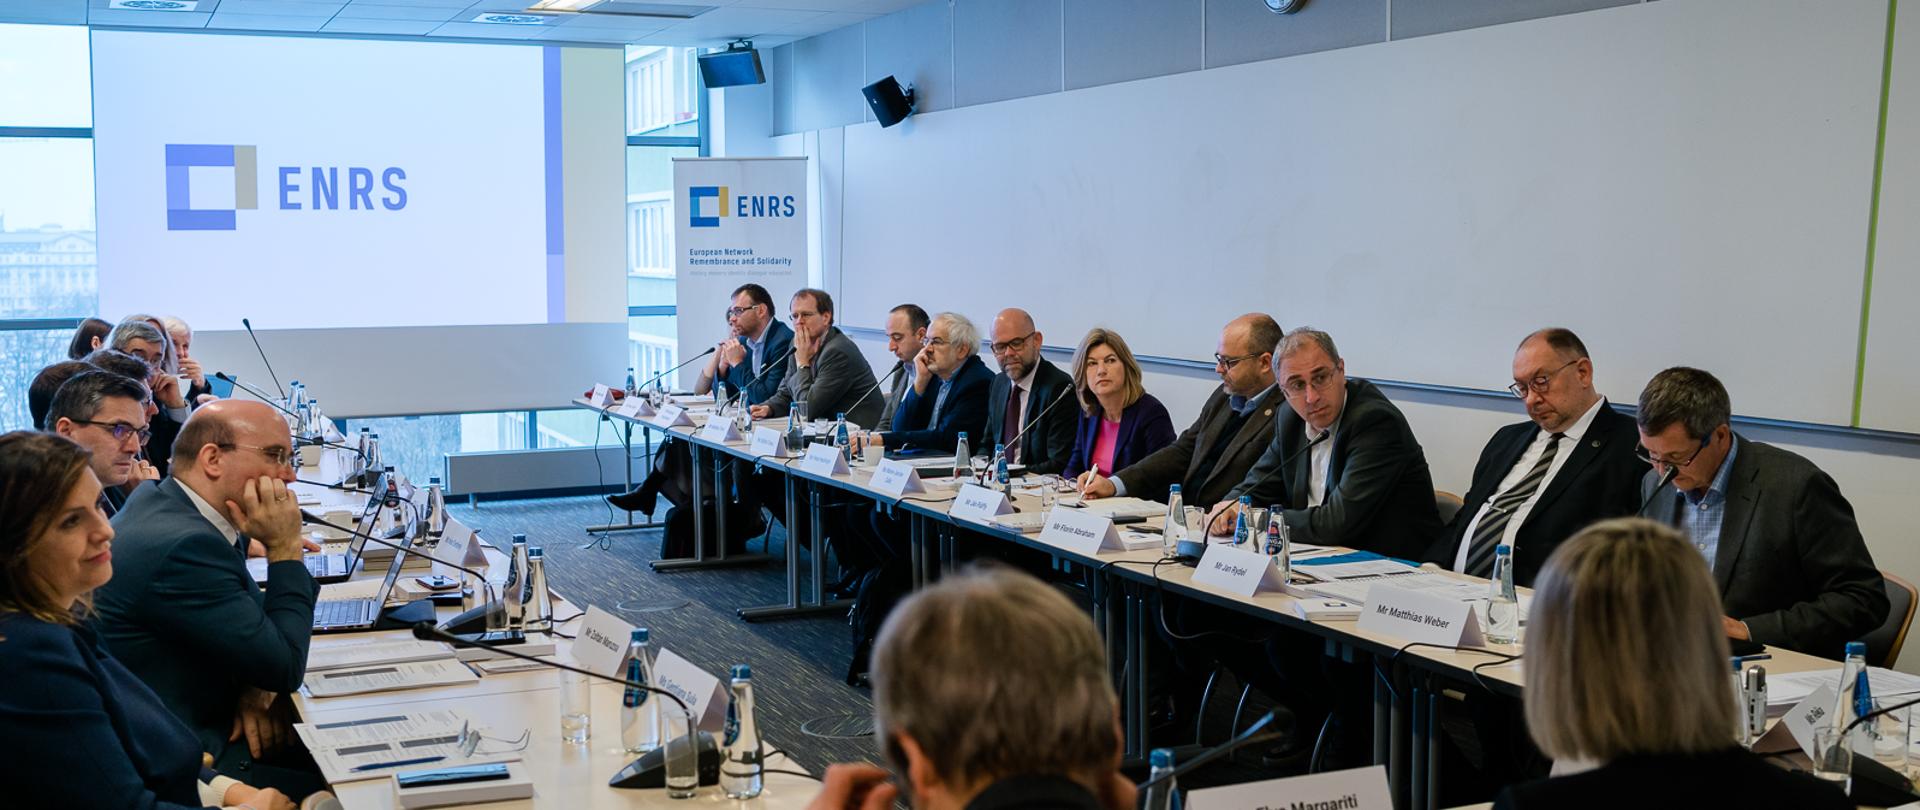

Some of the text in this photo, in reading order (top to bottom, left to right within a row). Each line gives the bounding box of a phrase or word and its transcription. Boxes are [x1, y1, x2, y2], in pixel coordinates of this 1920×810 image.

[279, 167, 407, 210] ENRS
[737, 195, 796, 218] ENRS
[689, 248, 753, 257] European Network
[689, 256, 792, 266] Remembrance and Solidarity
[1053, 522, 1096, 539] Mr Florin Abraham
[1214, 561, 1248, 576] Mr Jan Rydel
[1376, 604, 1450, 629] Mr Matthias Weber
[1290, 794, 1359, 810] Margariti
